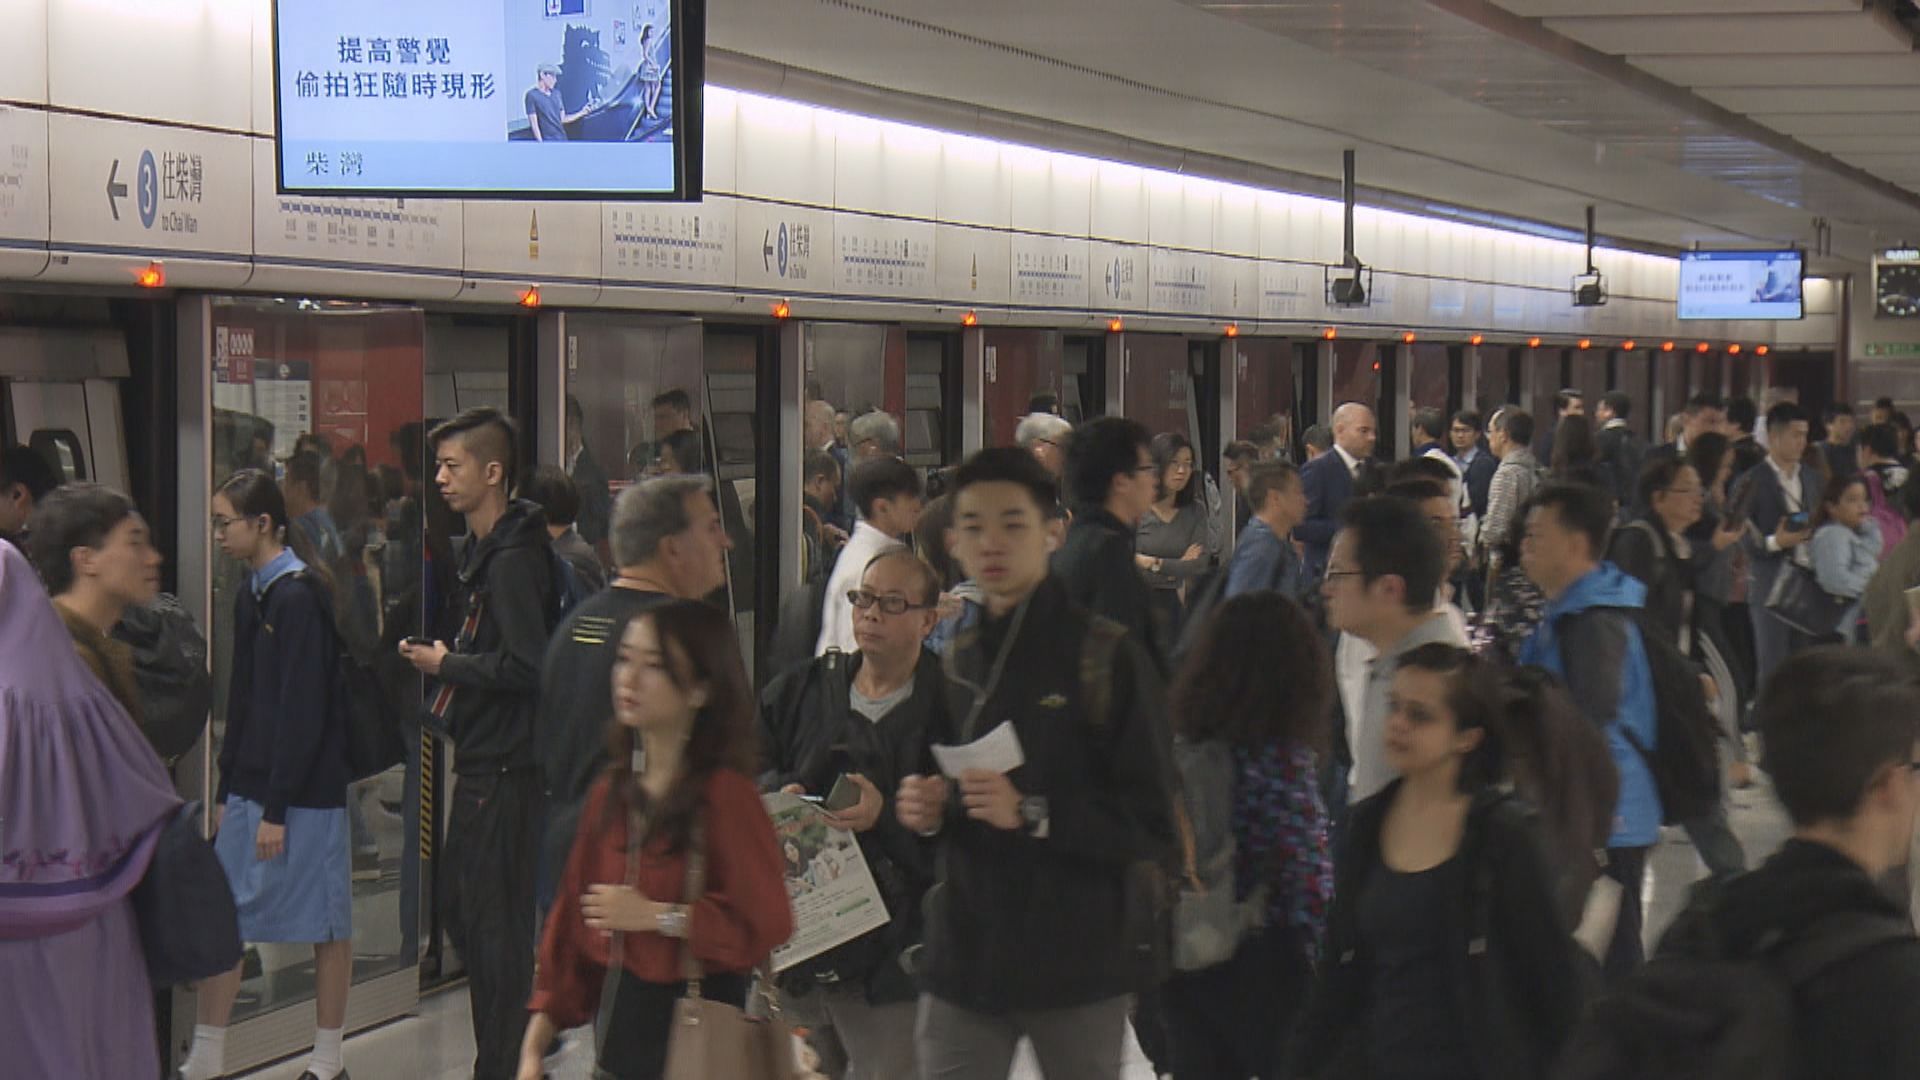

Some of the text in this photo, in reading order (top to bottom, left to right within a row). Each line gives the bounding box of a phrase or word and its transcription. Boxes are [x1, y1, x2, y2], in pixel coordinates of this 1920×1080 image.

[337, 36, 451, 65] 提高警覺
[295, 70, 496, 100] 偷拍狂隨時現形
[143, 164, 152, 214] 3
[162, 151, 202, 203] 往柴灣
